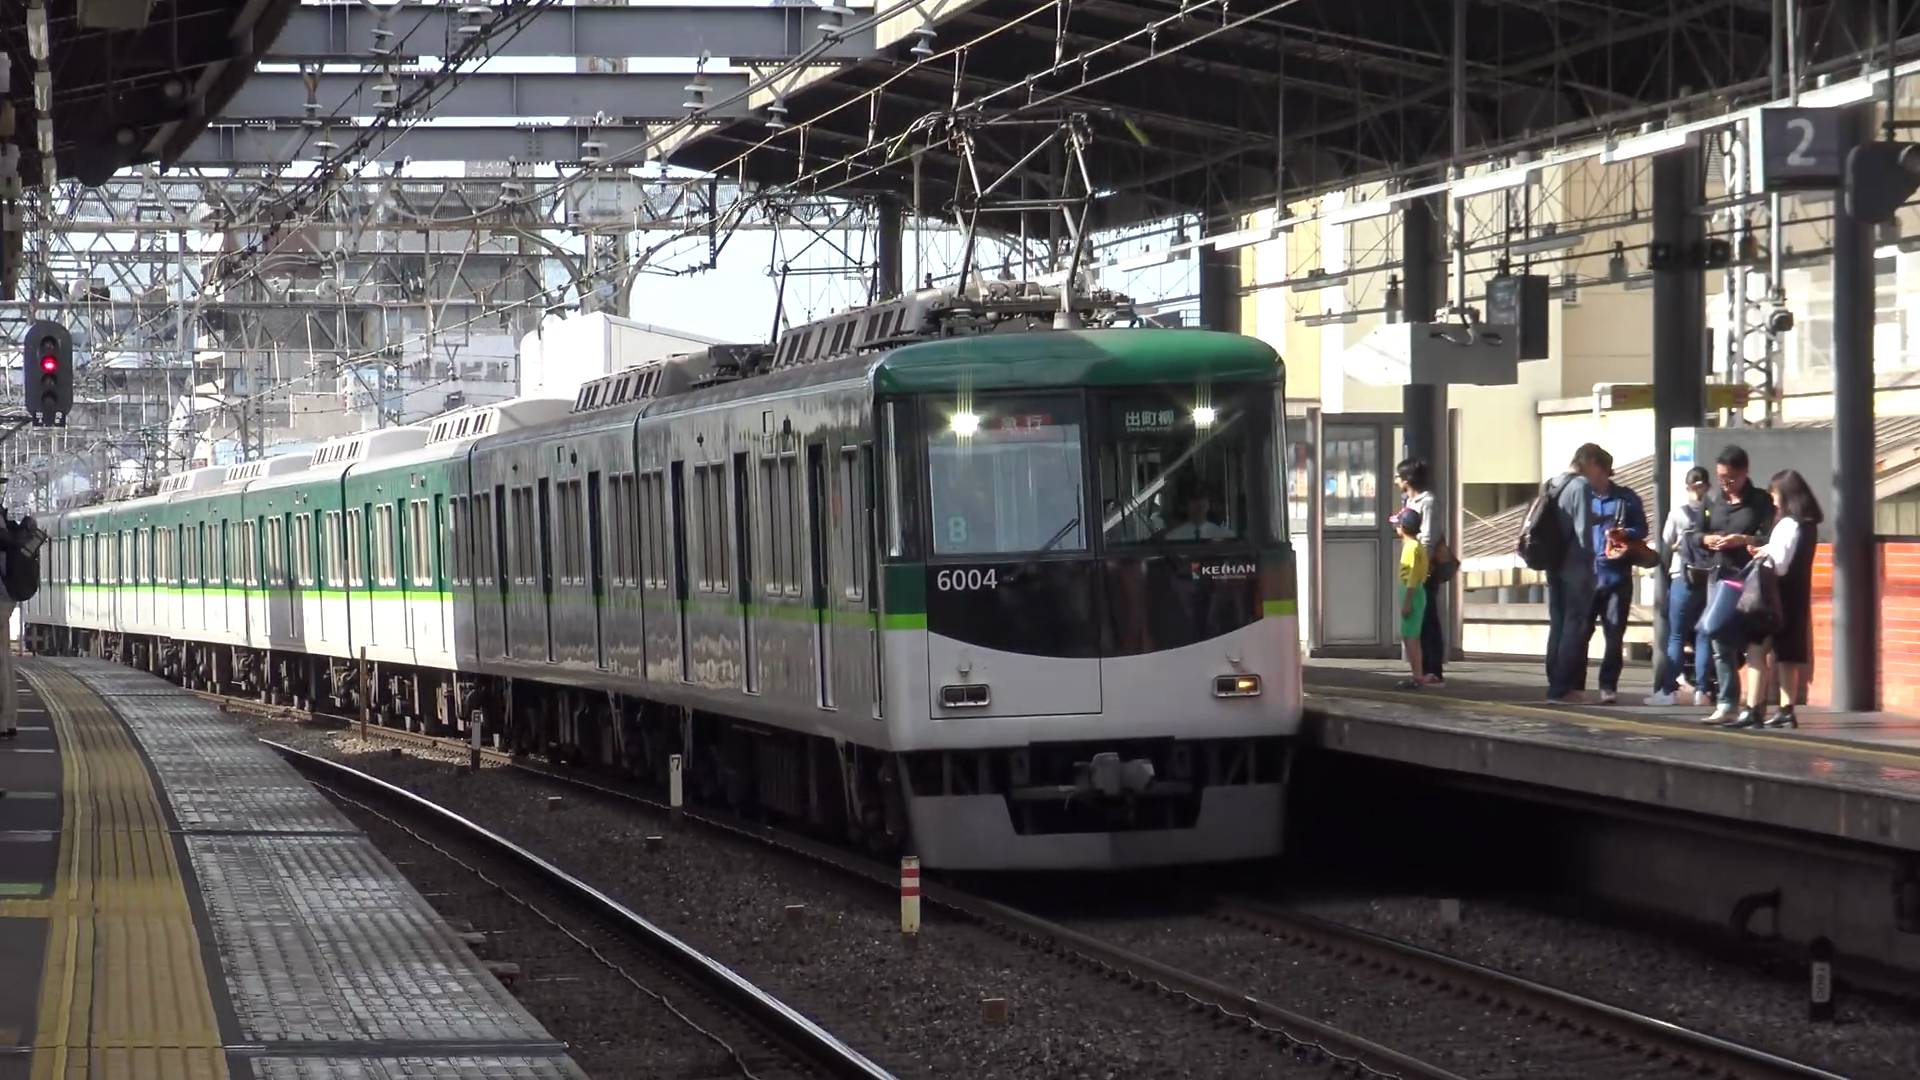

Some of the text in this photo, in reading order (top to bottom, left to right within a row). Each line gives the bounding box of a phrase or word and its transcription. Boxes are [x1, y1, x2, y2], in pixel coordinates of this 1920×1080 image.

[1787, 118, 1816, 166] 2
[1125, 410, 1174, 426] 出町柳
[1201, 564, 1256, 575] KEIHAN
[937, 569, 998, 590] 6004
[672, 757, 680, 771] 7
